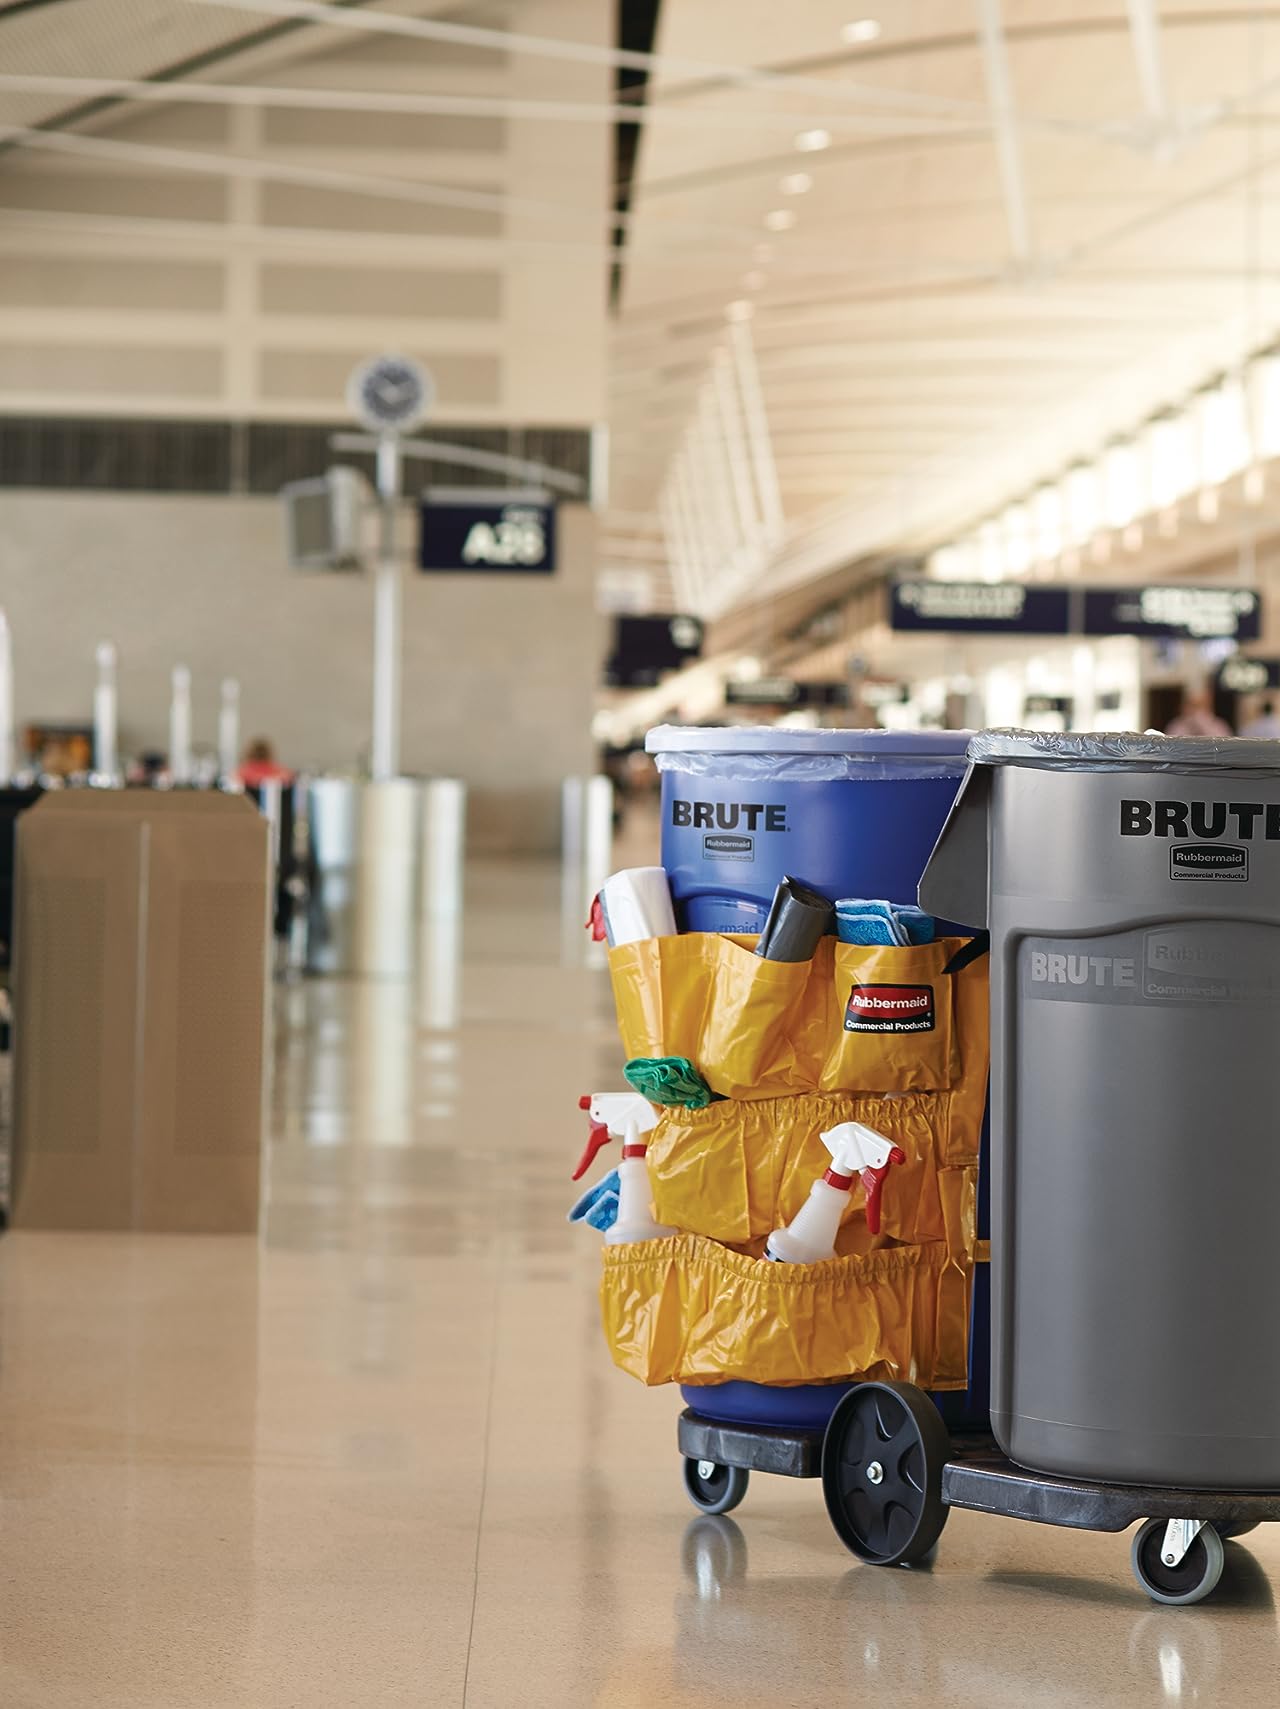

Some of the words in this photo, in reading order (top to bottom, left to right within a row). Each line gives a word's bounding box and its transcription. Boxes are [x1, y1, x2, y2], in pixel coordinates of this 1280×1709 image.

[672, 800, 786, 832] BRUTE
[706, 839, 751, 848] Rubbermaid
[1176, 852, 1242, 863] Rubbermaid
[1031, 951, 1137, 987] BRUTE
[852, 995, 928, 1009] Rubbermaid
[845, 1020, 894, 1030] Commercial
[895, 1021, 931, 1031] Products
